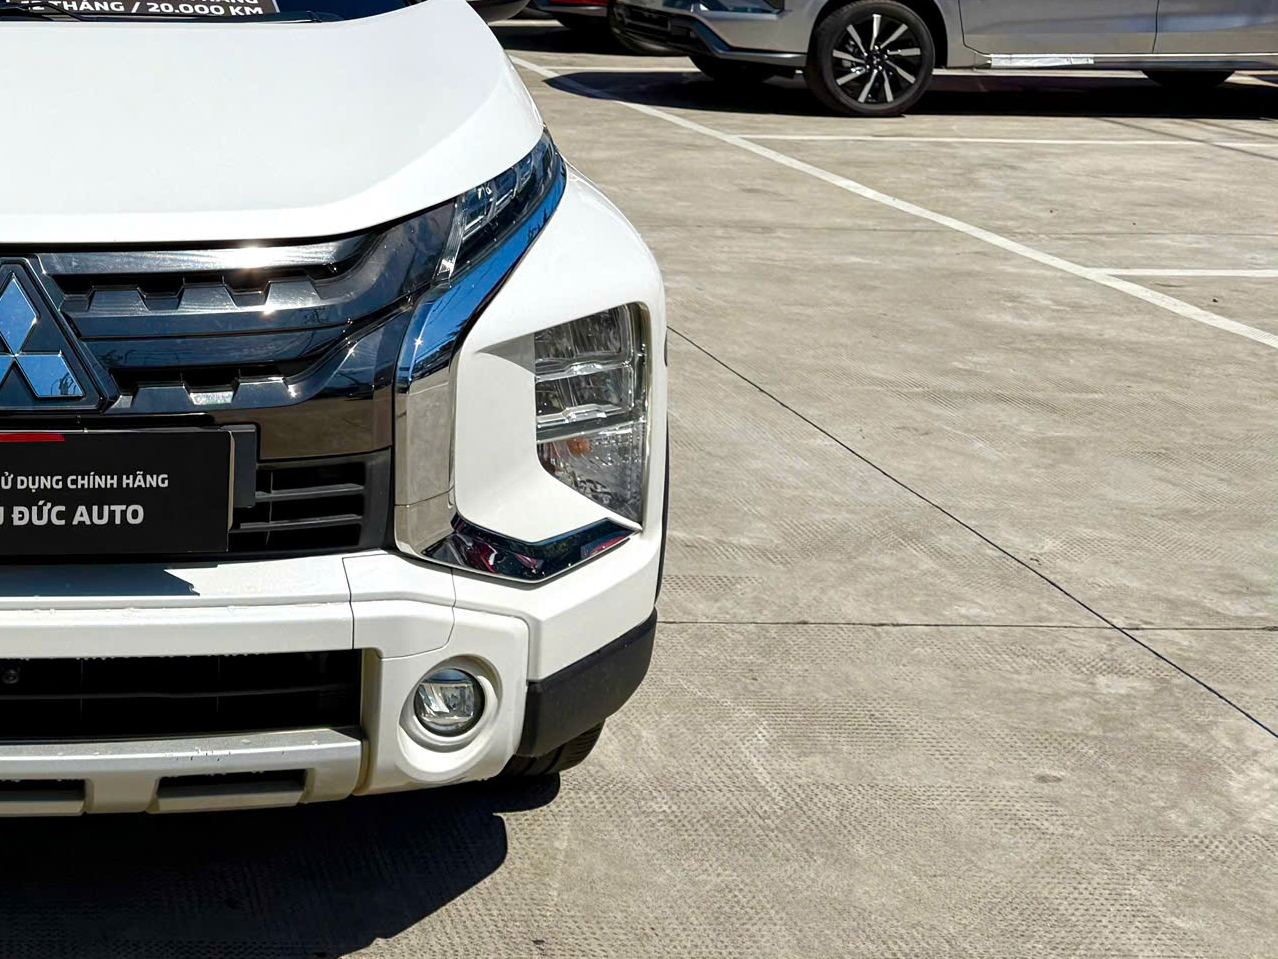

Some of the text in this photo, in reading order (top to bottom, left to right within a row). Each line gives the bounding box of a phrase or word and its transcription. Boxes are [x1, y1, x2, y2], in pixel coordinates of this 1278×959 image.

[131, 1, 141, 13] /
[146, 2, 225, 15] 20.000
[229, 5, 264, 16] KM
[17, 475, 63, 492] DỤNG
[67, 471, 118, 489] CHÍNH
[122, 471, 169, 488] HÃNG
[11, 500, 66, 526] ĐỨC
[72, 504, 145, 525] AUTO
